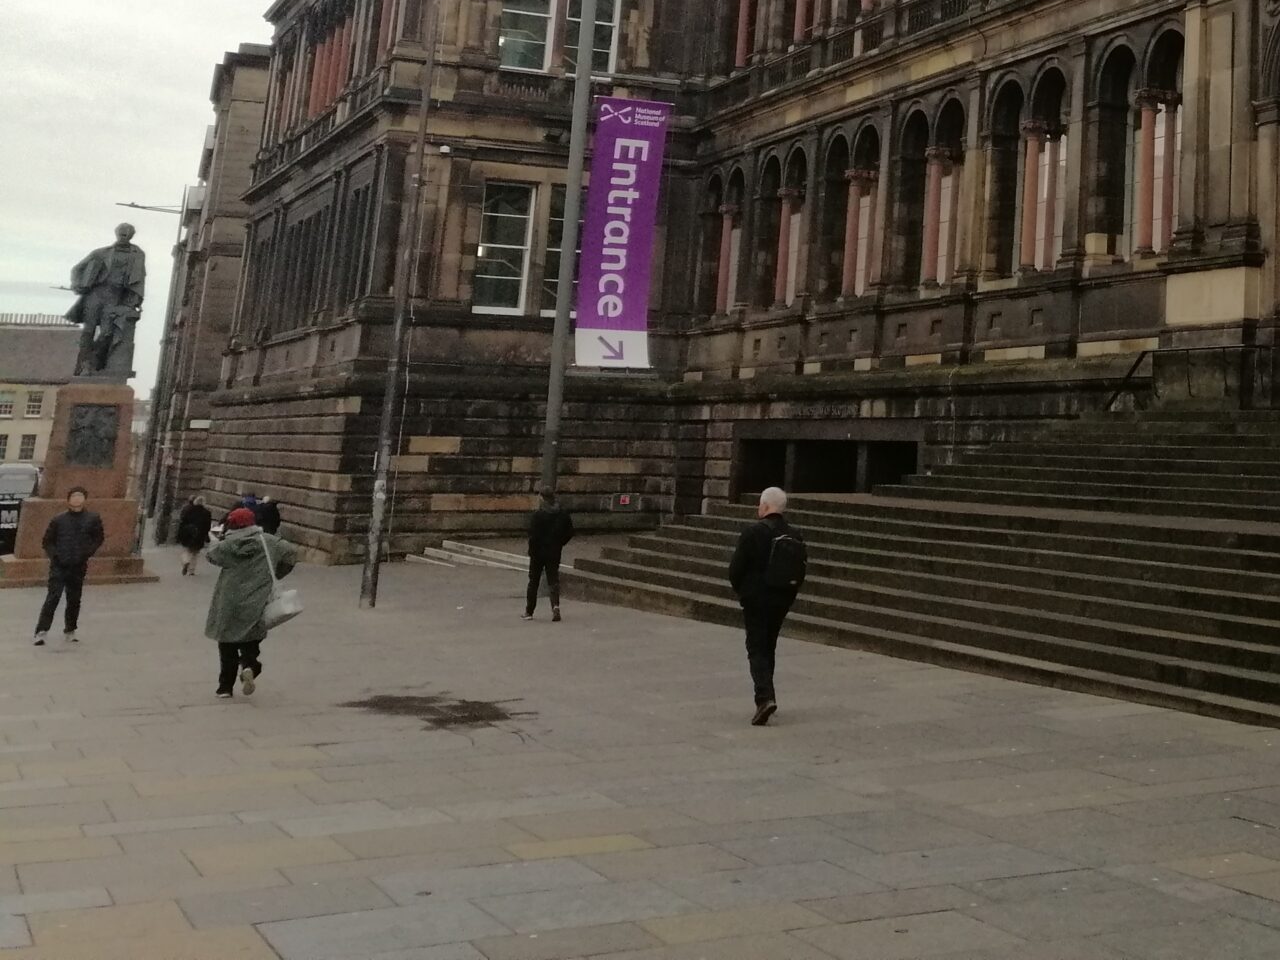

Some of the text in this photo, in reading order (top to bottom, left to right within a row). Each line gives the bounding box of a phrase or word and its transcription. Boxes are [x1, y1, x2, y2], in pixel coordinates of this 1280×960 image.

[635, 107, 662, 116] National
[634, 113, 659, 121] Museum
[633, 119, 660, 127] Scotland
[597, 137, 649, 319] Entrance
